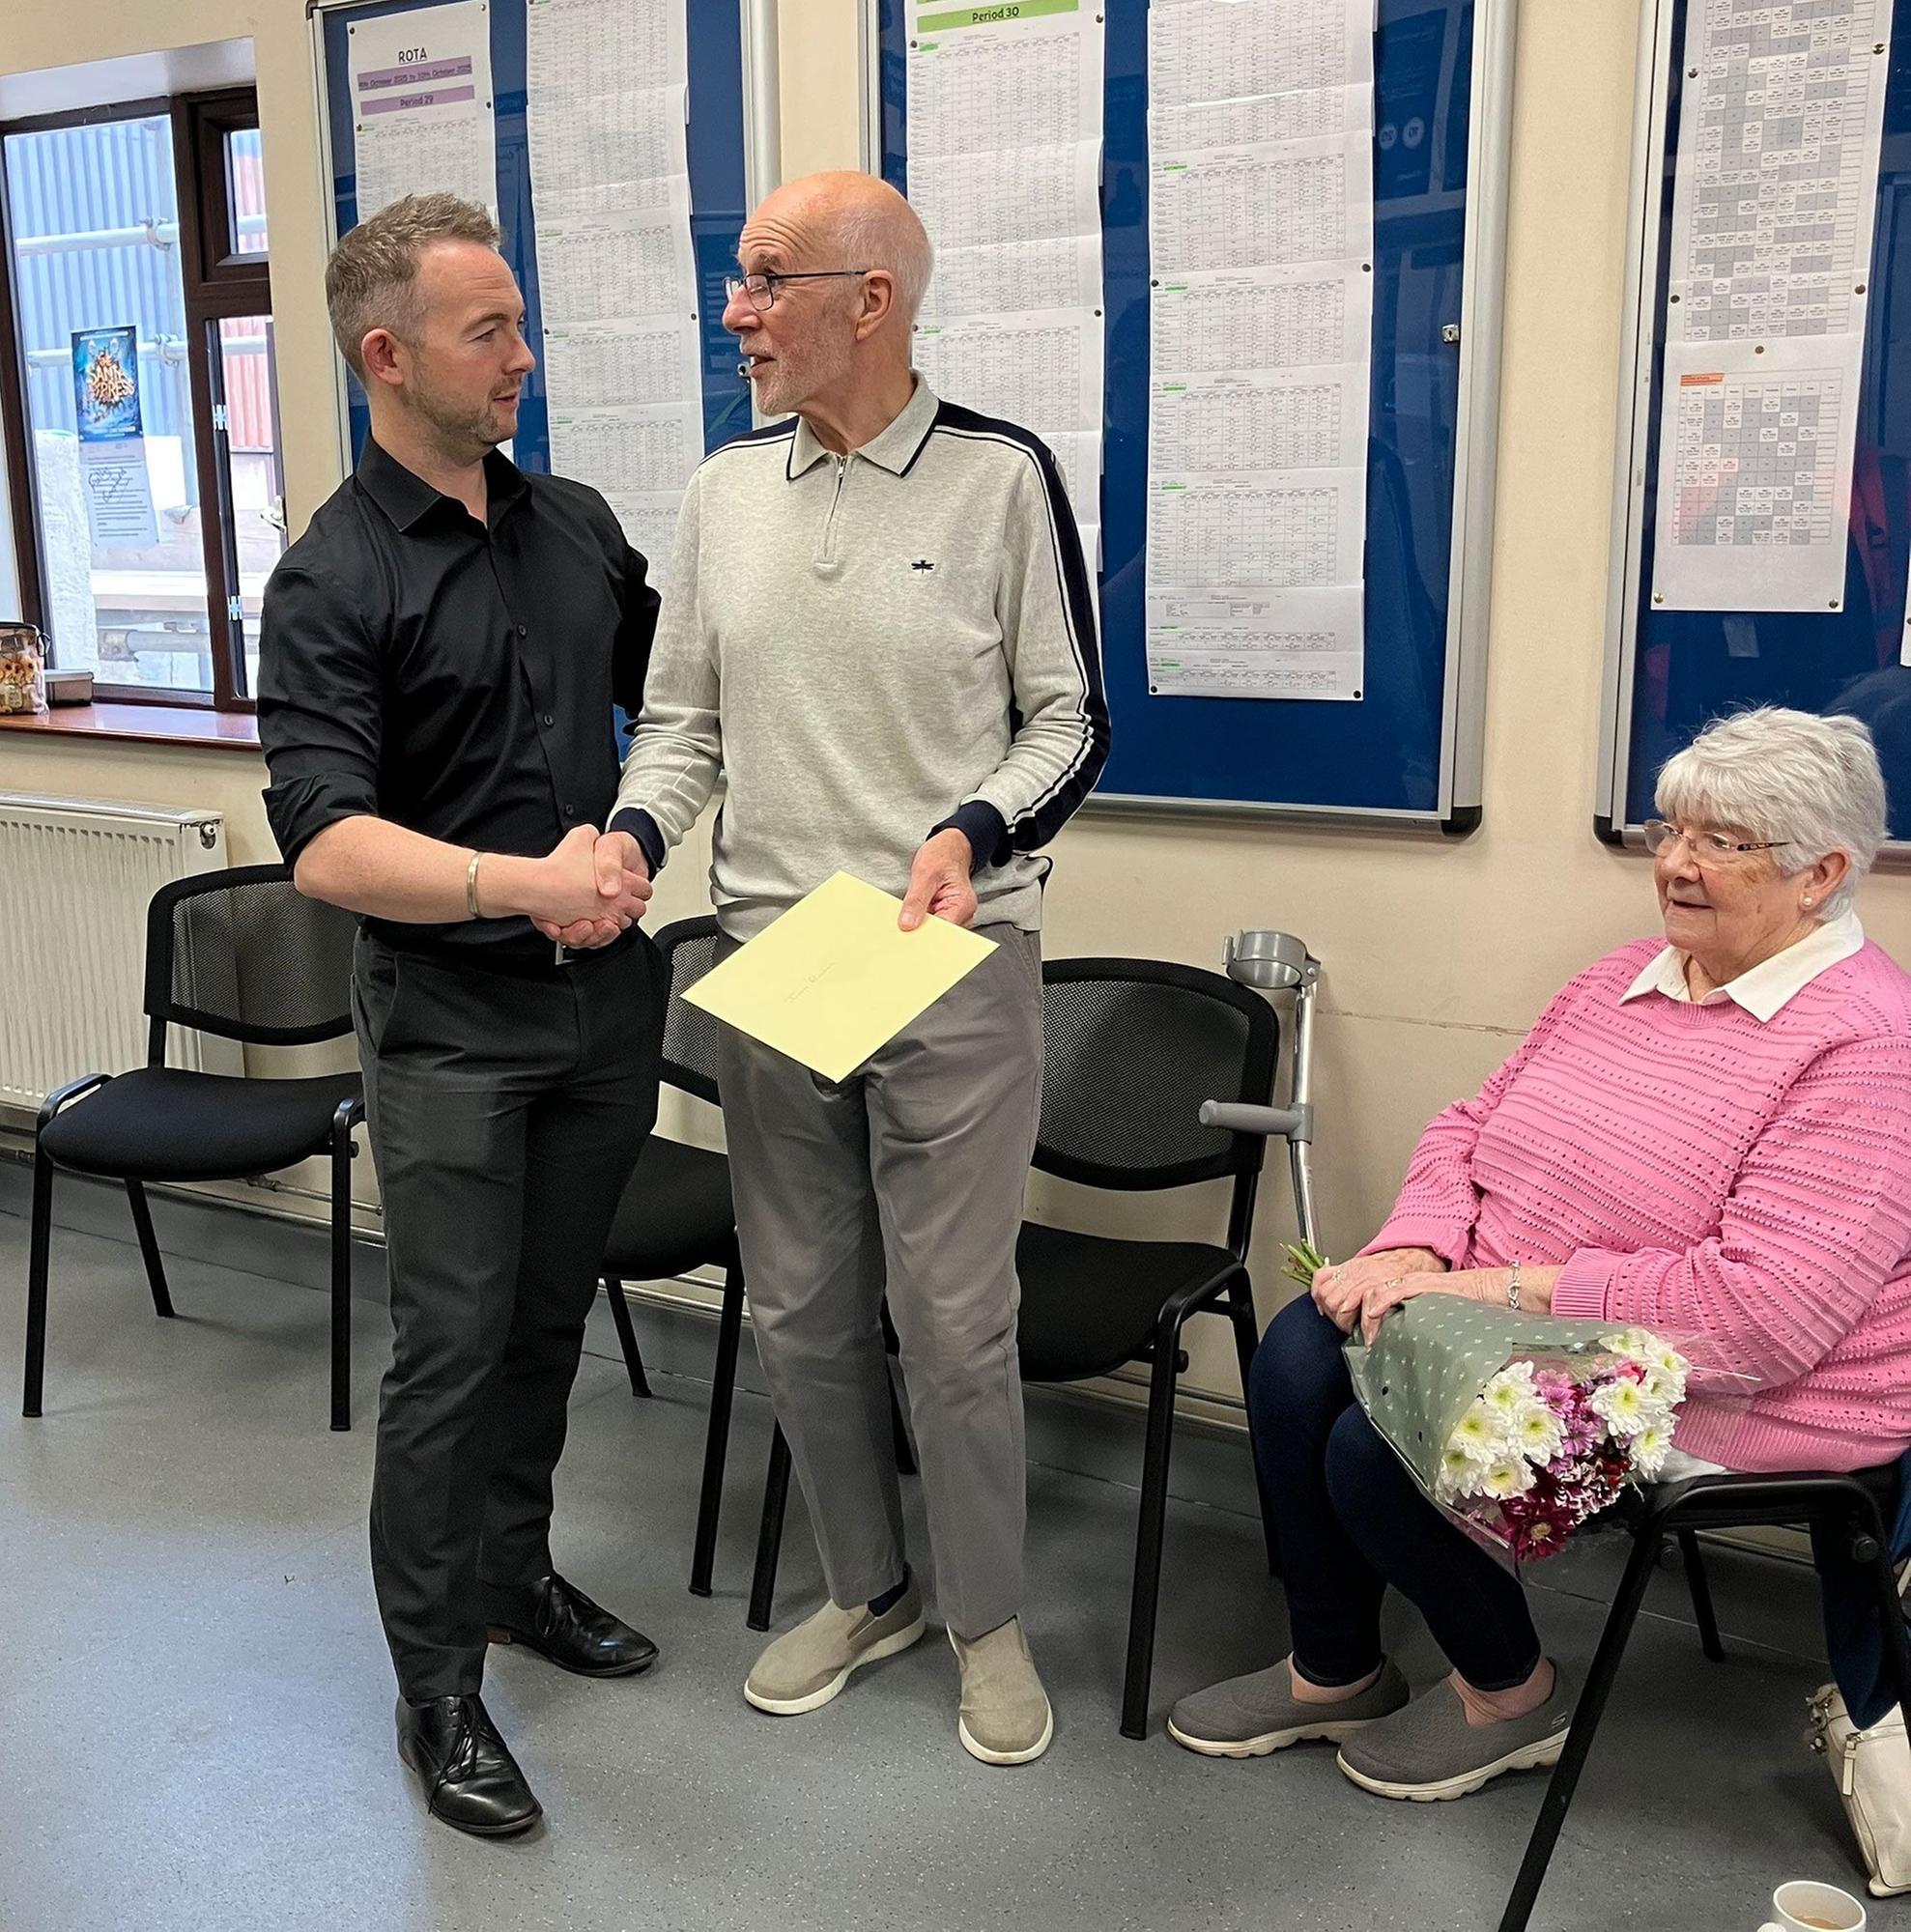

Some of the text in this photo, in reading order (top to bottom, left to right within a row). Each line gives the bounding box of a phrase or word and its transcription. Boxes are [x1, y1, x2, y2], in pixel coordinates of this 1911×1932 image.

[972, 6, 1019, 23] Period 30
[398, 47, 428, 64] ROTA
[400, 96, 423, 107] Period
